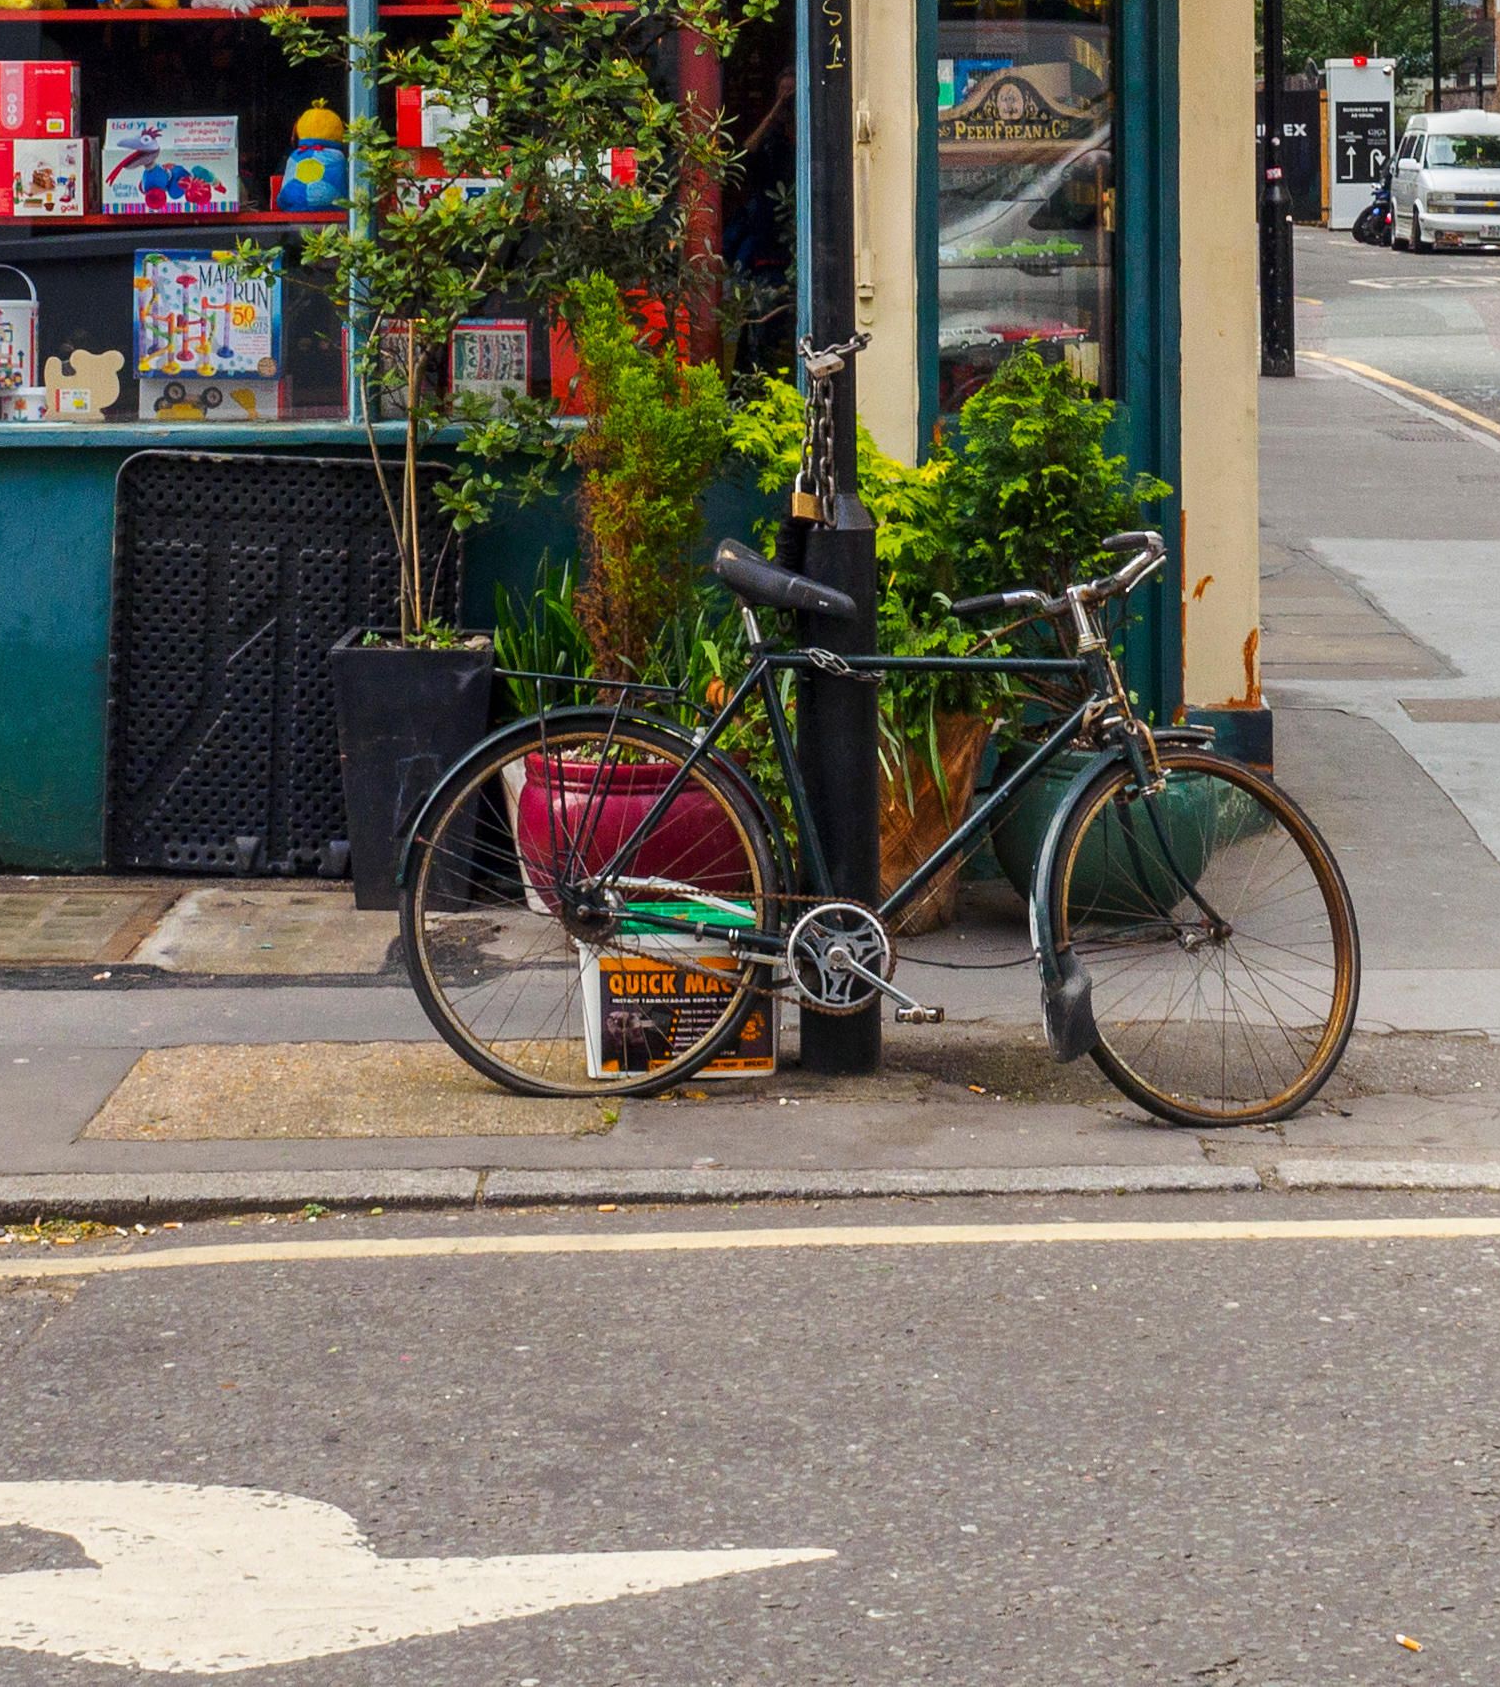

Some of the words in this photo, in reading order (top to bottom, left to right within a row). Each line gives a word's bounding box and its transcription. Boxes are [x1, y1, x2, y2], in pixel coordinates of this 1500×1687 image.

[60, 204, 79, 213] goki
[233, 281, 269, 310] RUN
[232, 305, 256, 326] 50
[609, 973, 676, 995] QUICK
